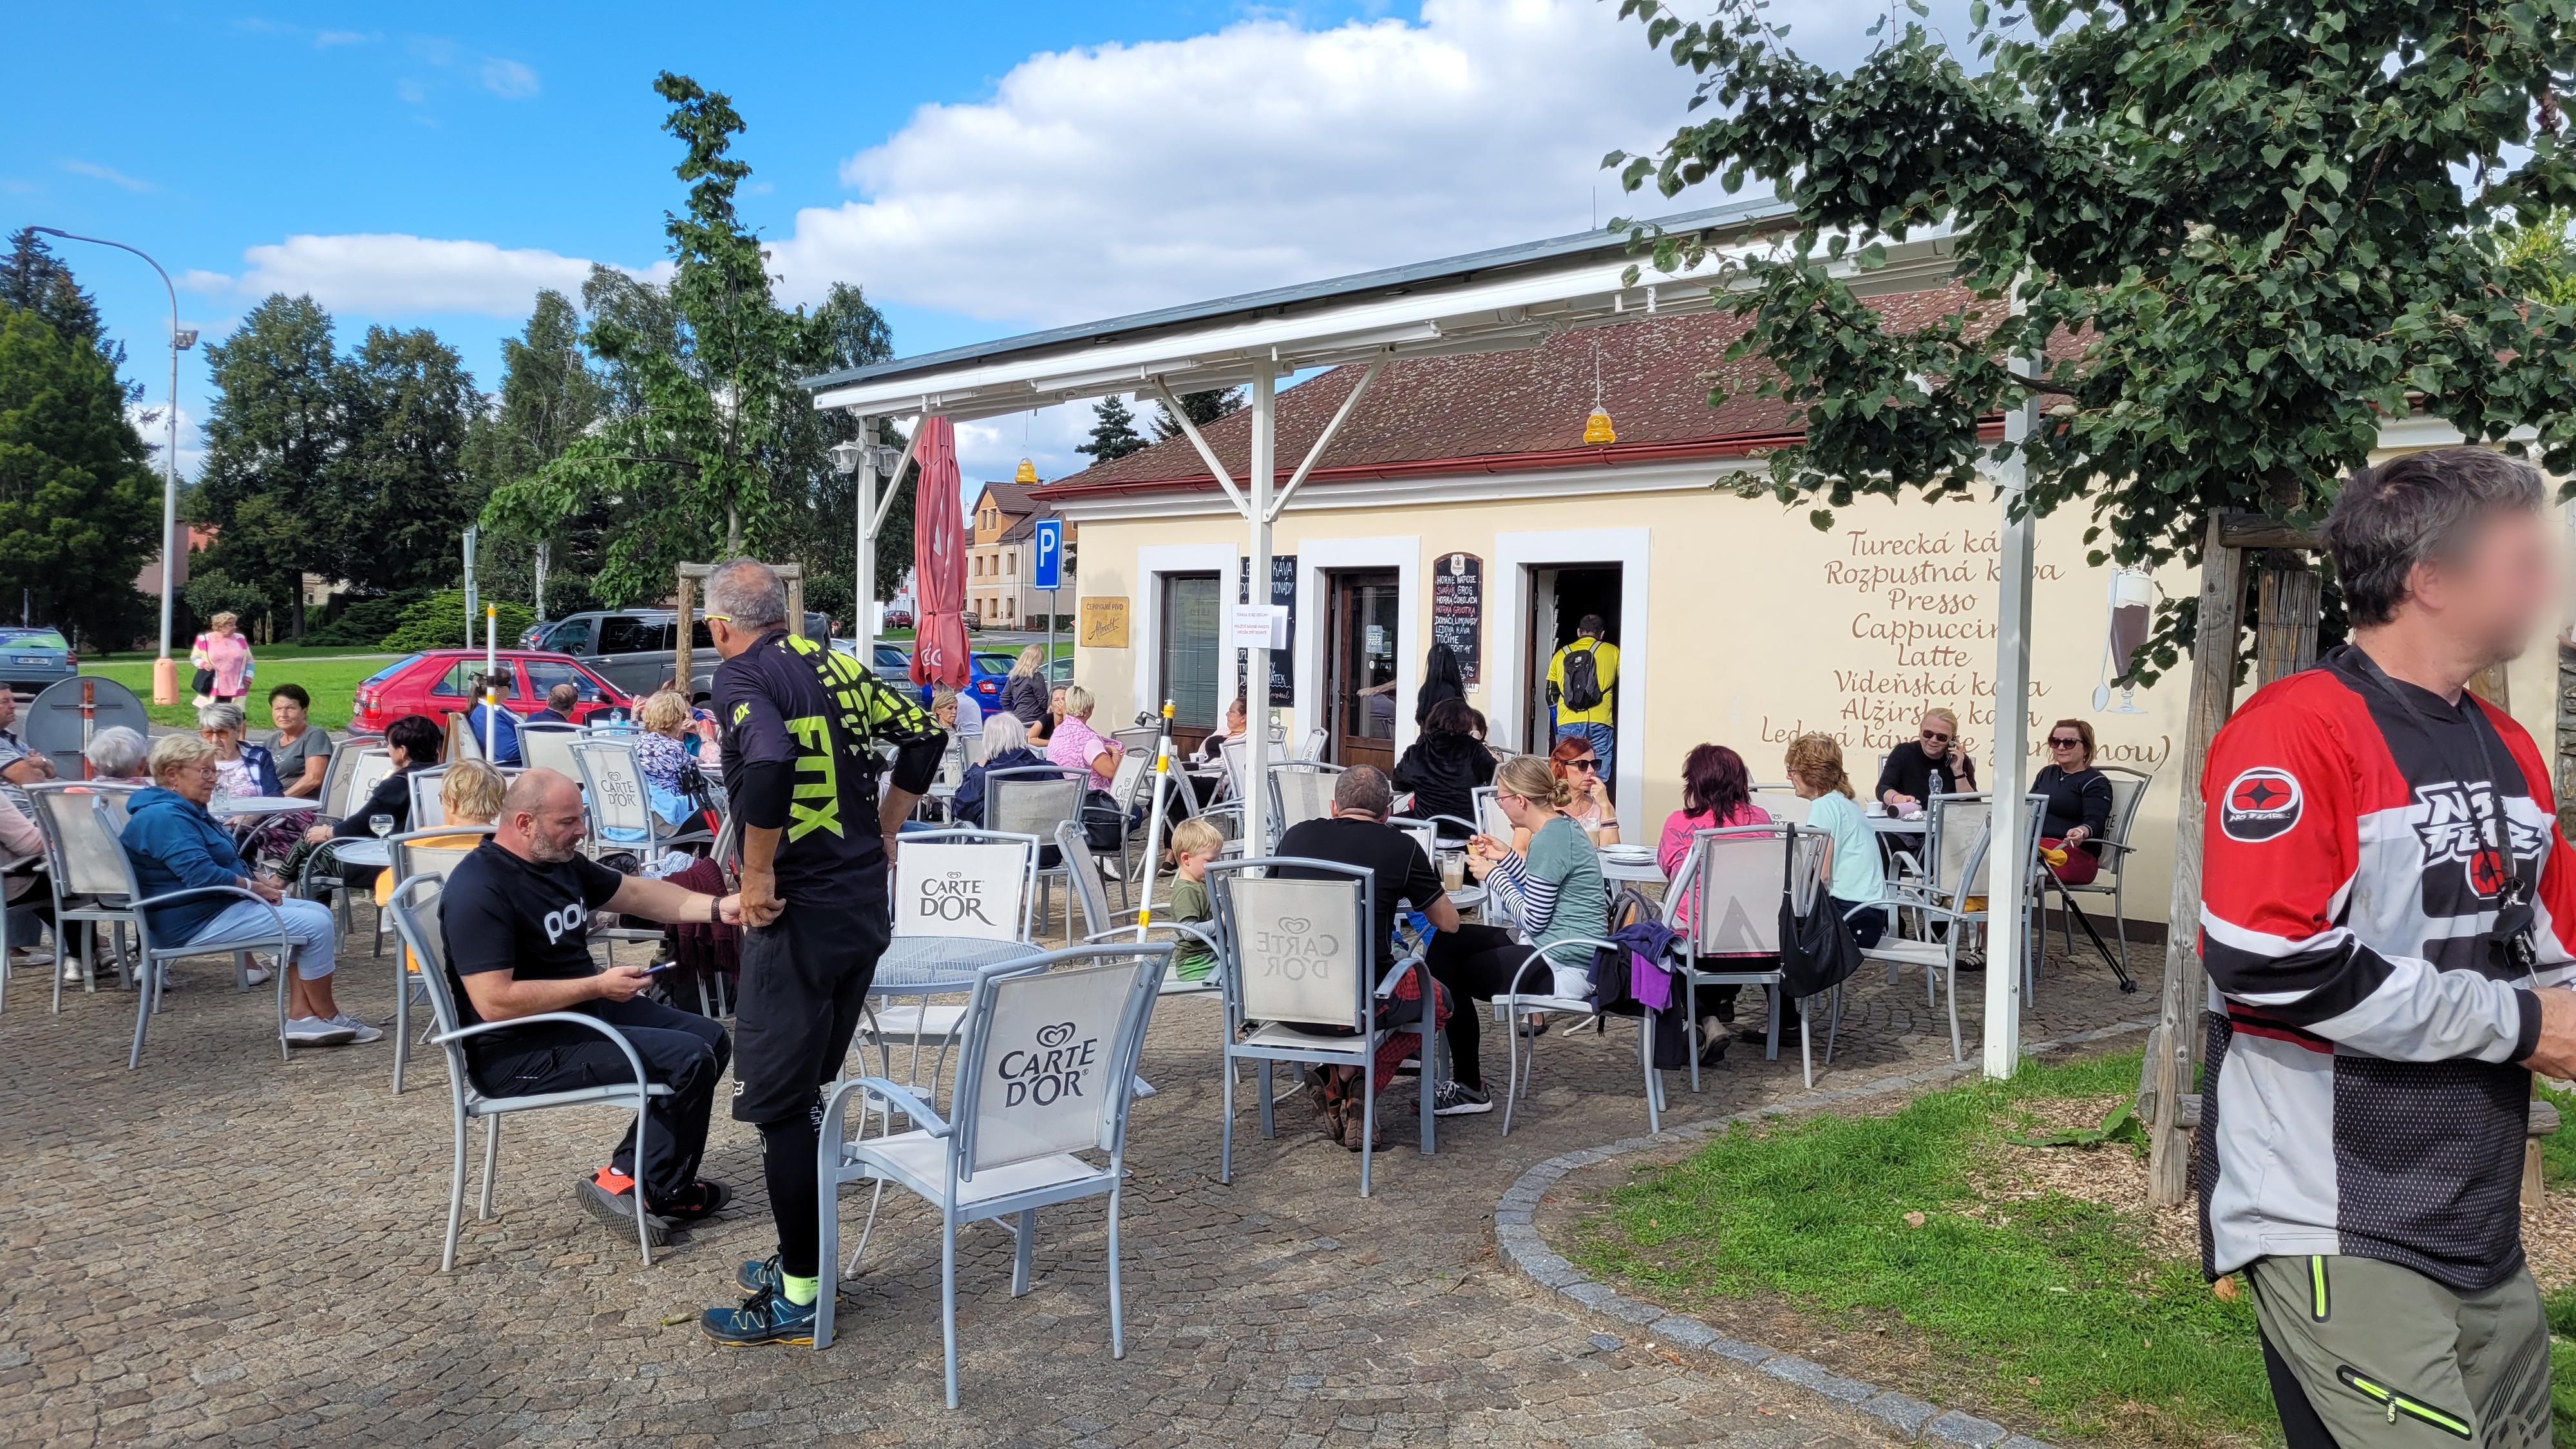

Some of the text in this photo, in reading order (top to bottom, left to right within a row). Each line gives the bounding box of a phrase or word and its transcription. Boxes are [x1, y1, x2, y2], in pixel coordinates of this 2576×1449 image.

[1040, 529, 1055, 567] P
[1847, 528, 1955, 556] Turecká
[1273, 556, 1293, 577] KÁVA
[1824, 560, 1976, 593] Rozpustná
[1086, 601, 1111, 611] ČEPOVANÉ
[1888, 588, 1978, 614] Presso
[1435, 633, 1459, 644] TOČÍME
[1852, 612, 1999, 646] Cappucci
[1897, 643, 1973, 667] Latte
[1833, 669, 1965, 697] Vídeňská
[601, 780, 635, 795] CARTE
[608, 793, 637, 807] D'OR
[1115, 785, 1131, 800] CART
[2228, 814, 2247, 822] NO
[921, 878, 981, 897] CARTE
[920, 895, 998, 926] D'OR
[998, 1037, 1097, 1080] CARTE
[1005, 1070, 1084, 1108] D'OR
